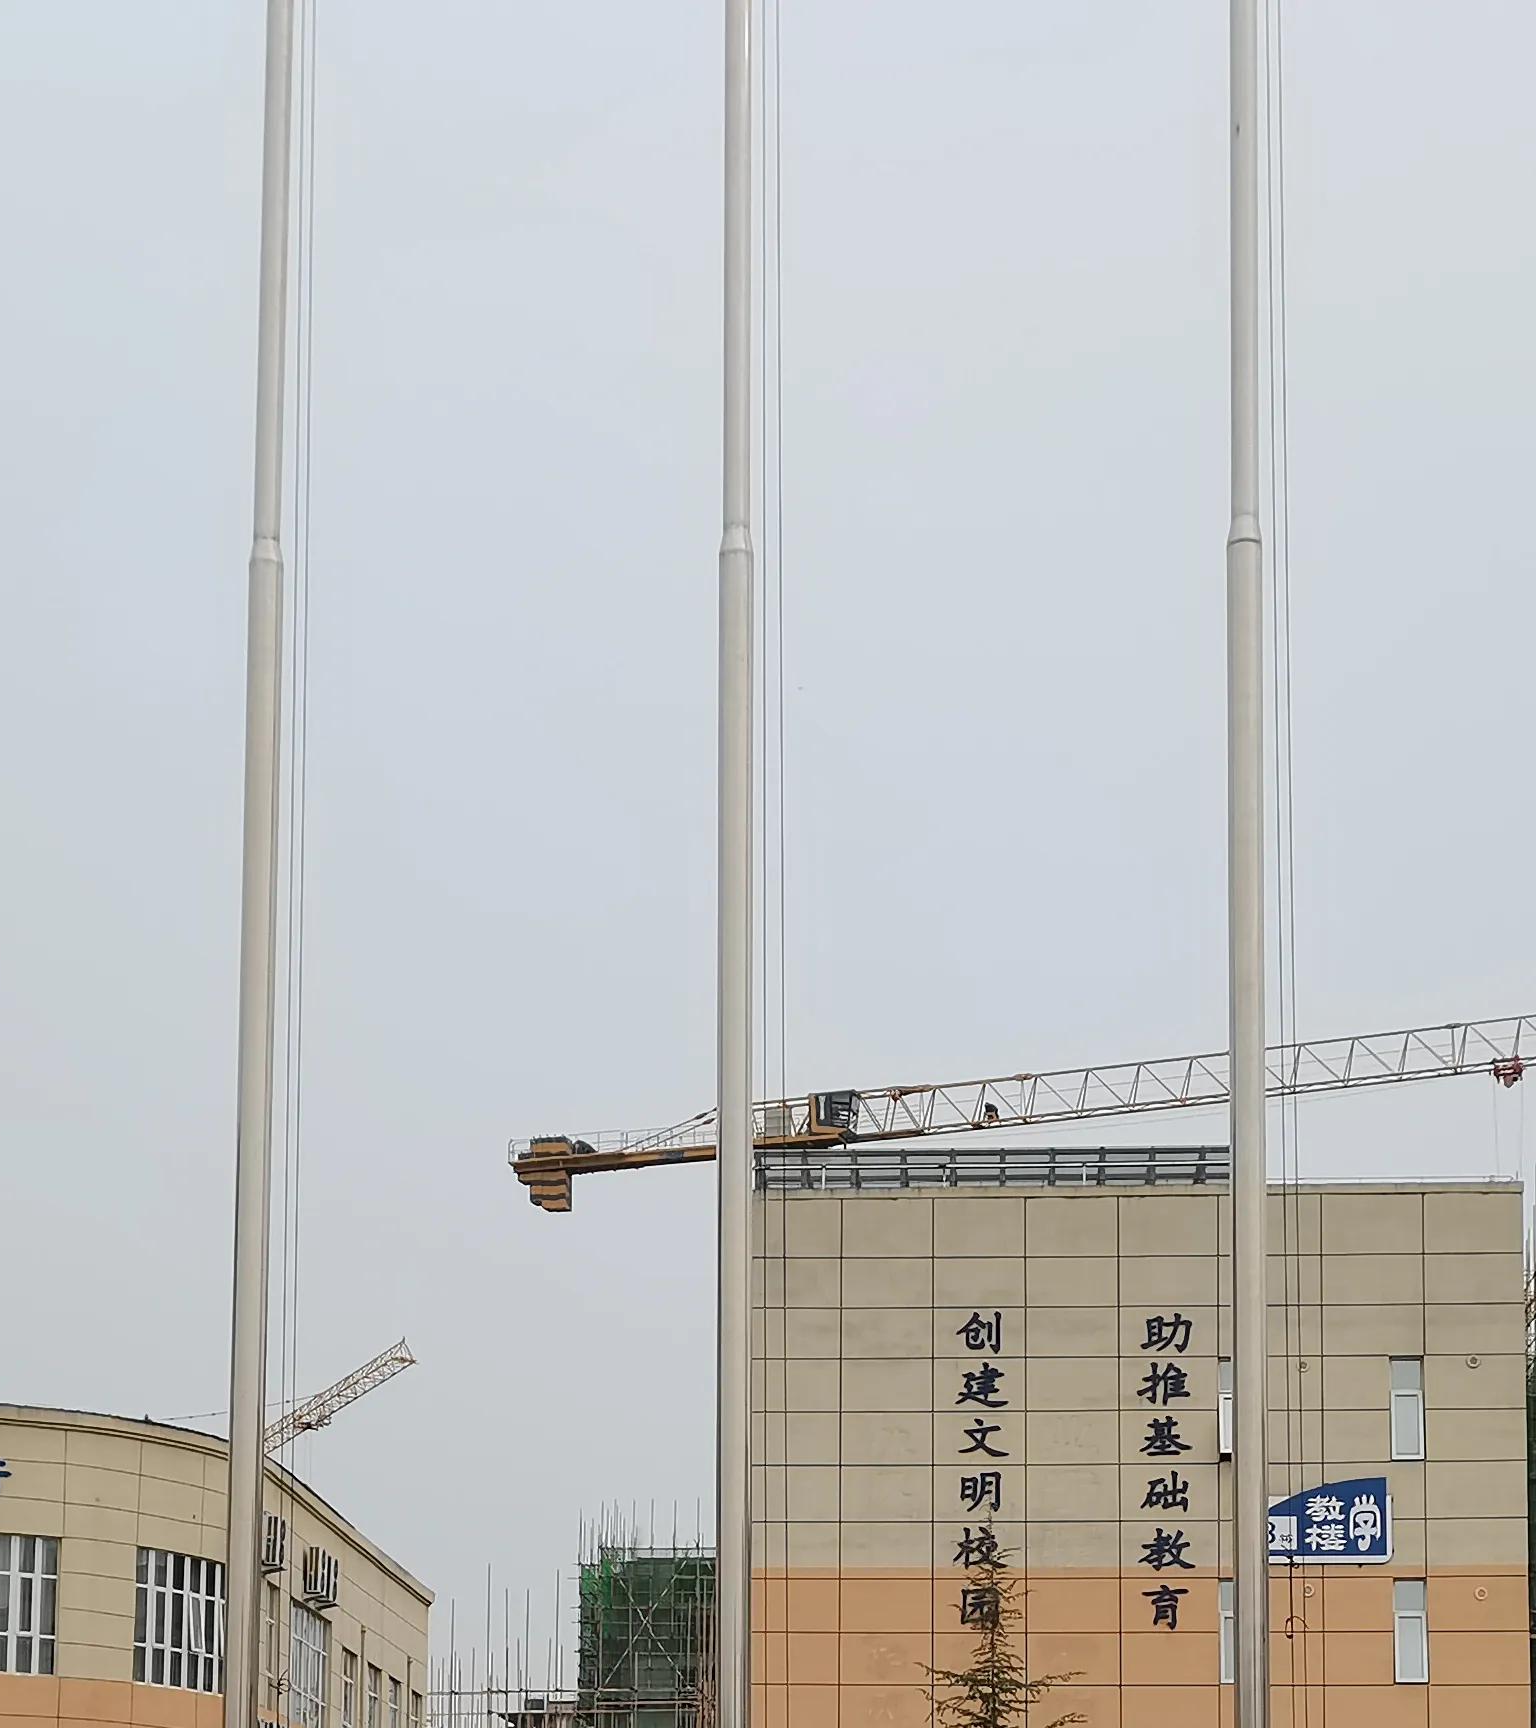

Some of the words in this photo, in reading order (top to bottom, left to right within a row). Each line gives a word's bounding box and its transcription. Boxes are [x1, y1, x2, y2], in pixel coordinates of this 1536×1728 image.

[953, 1311, 1010, 1627] 创建文明校园
[1137, 1312, 1196, 1630] 助推基础教育
